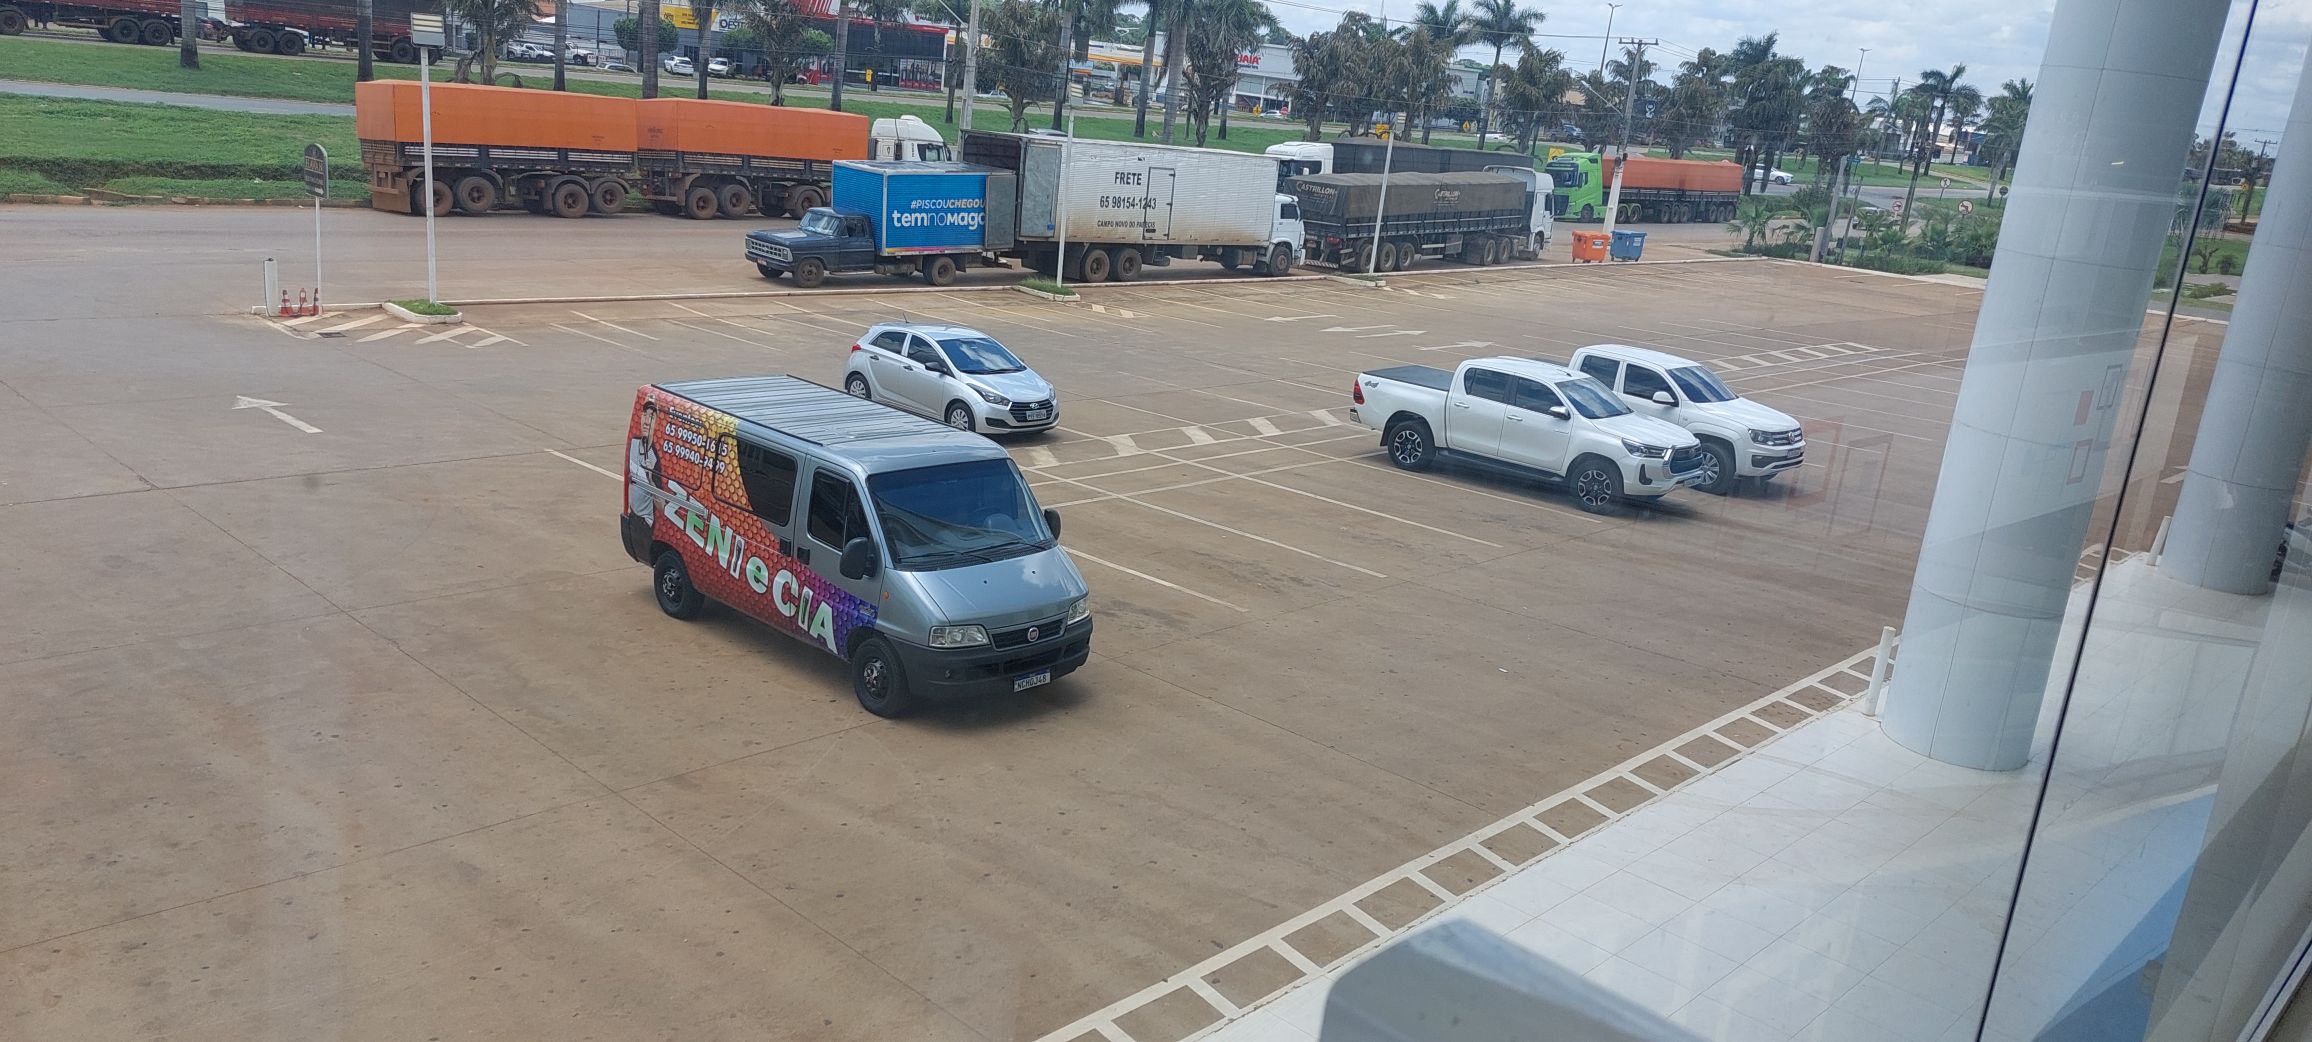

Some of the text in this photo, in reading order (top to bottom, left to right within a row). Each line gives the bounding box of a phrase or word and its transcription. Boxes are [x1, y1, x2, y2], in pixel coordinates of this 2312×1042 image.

[1114, 172, 1142, 185] FRETE
[1100, 196, 1157, 210] 65 98154-1243
[1097, 220, 1114, 228] CAMPO
[1115, 220, 1128, 228] NOVO
[665, 423, 676, 437] 65
[663, 440, 674, 454] 65
[746, 556, 769, 594] e
[773, 569, 838, 655] CIA
